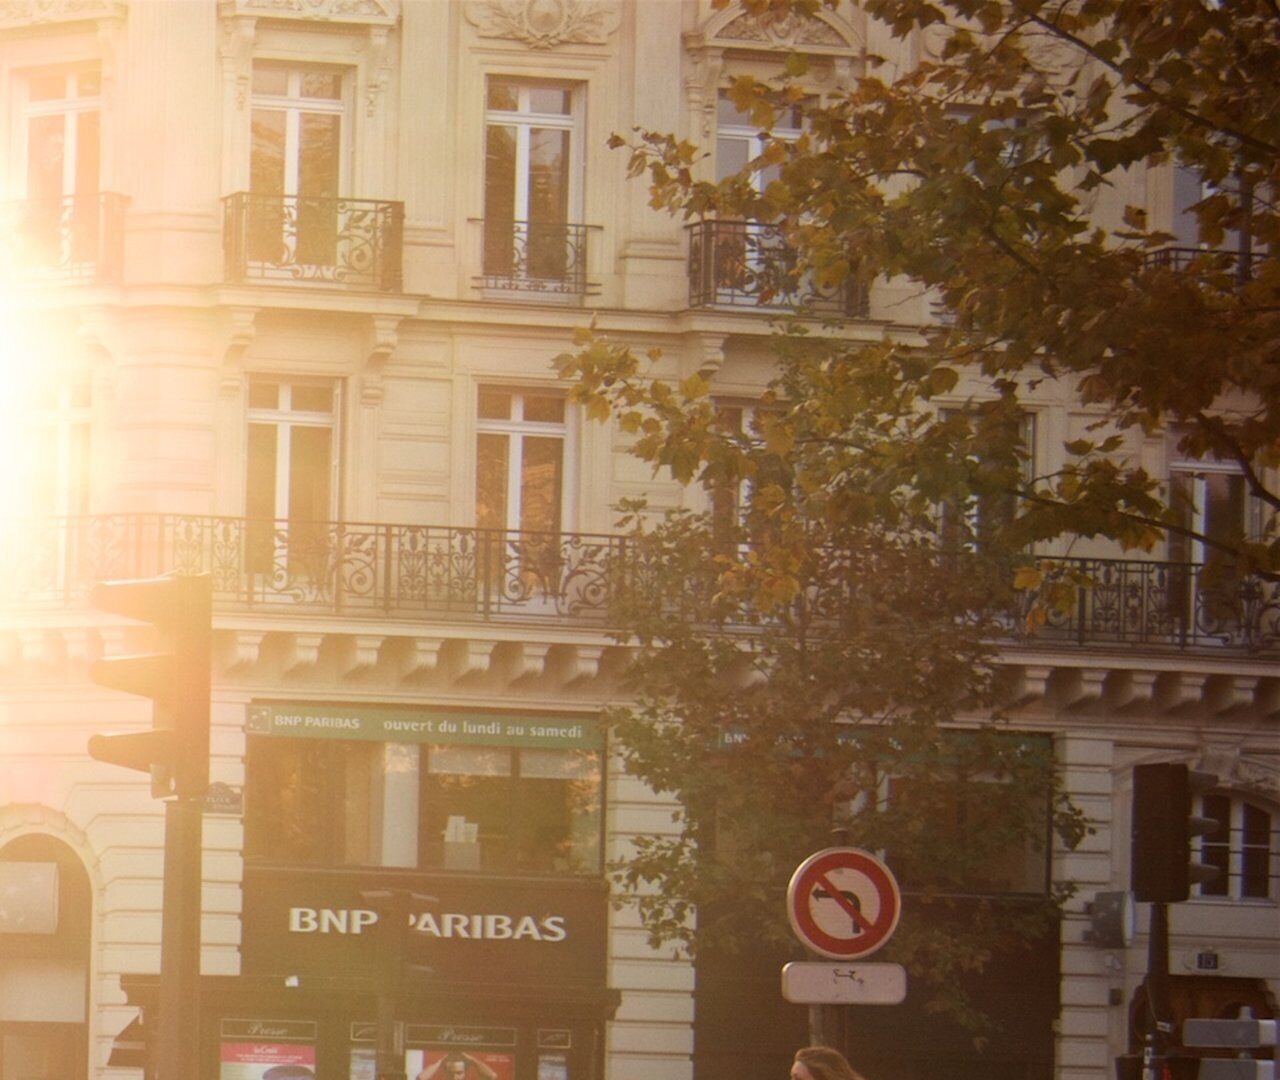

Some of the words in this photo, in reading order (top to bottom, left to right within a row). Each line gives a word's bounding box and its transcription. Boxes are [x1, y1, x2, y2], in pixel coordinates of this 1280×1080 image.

[274, 715, 302, 726] BNP
[305, 716, 360, 729] PARIBAS
[384, 720, 433, 731] ouvert
[438, 721, 457, 733] du
[463, 721, 500, 735] lundi
[507, 724, 524, 736] au
[529, 725, 582, 738] samedi
[289, 908, 378, 934] BNP
